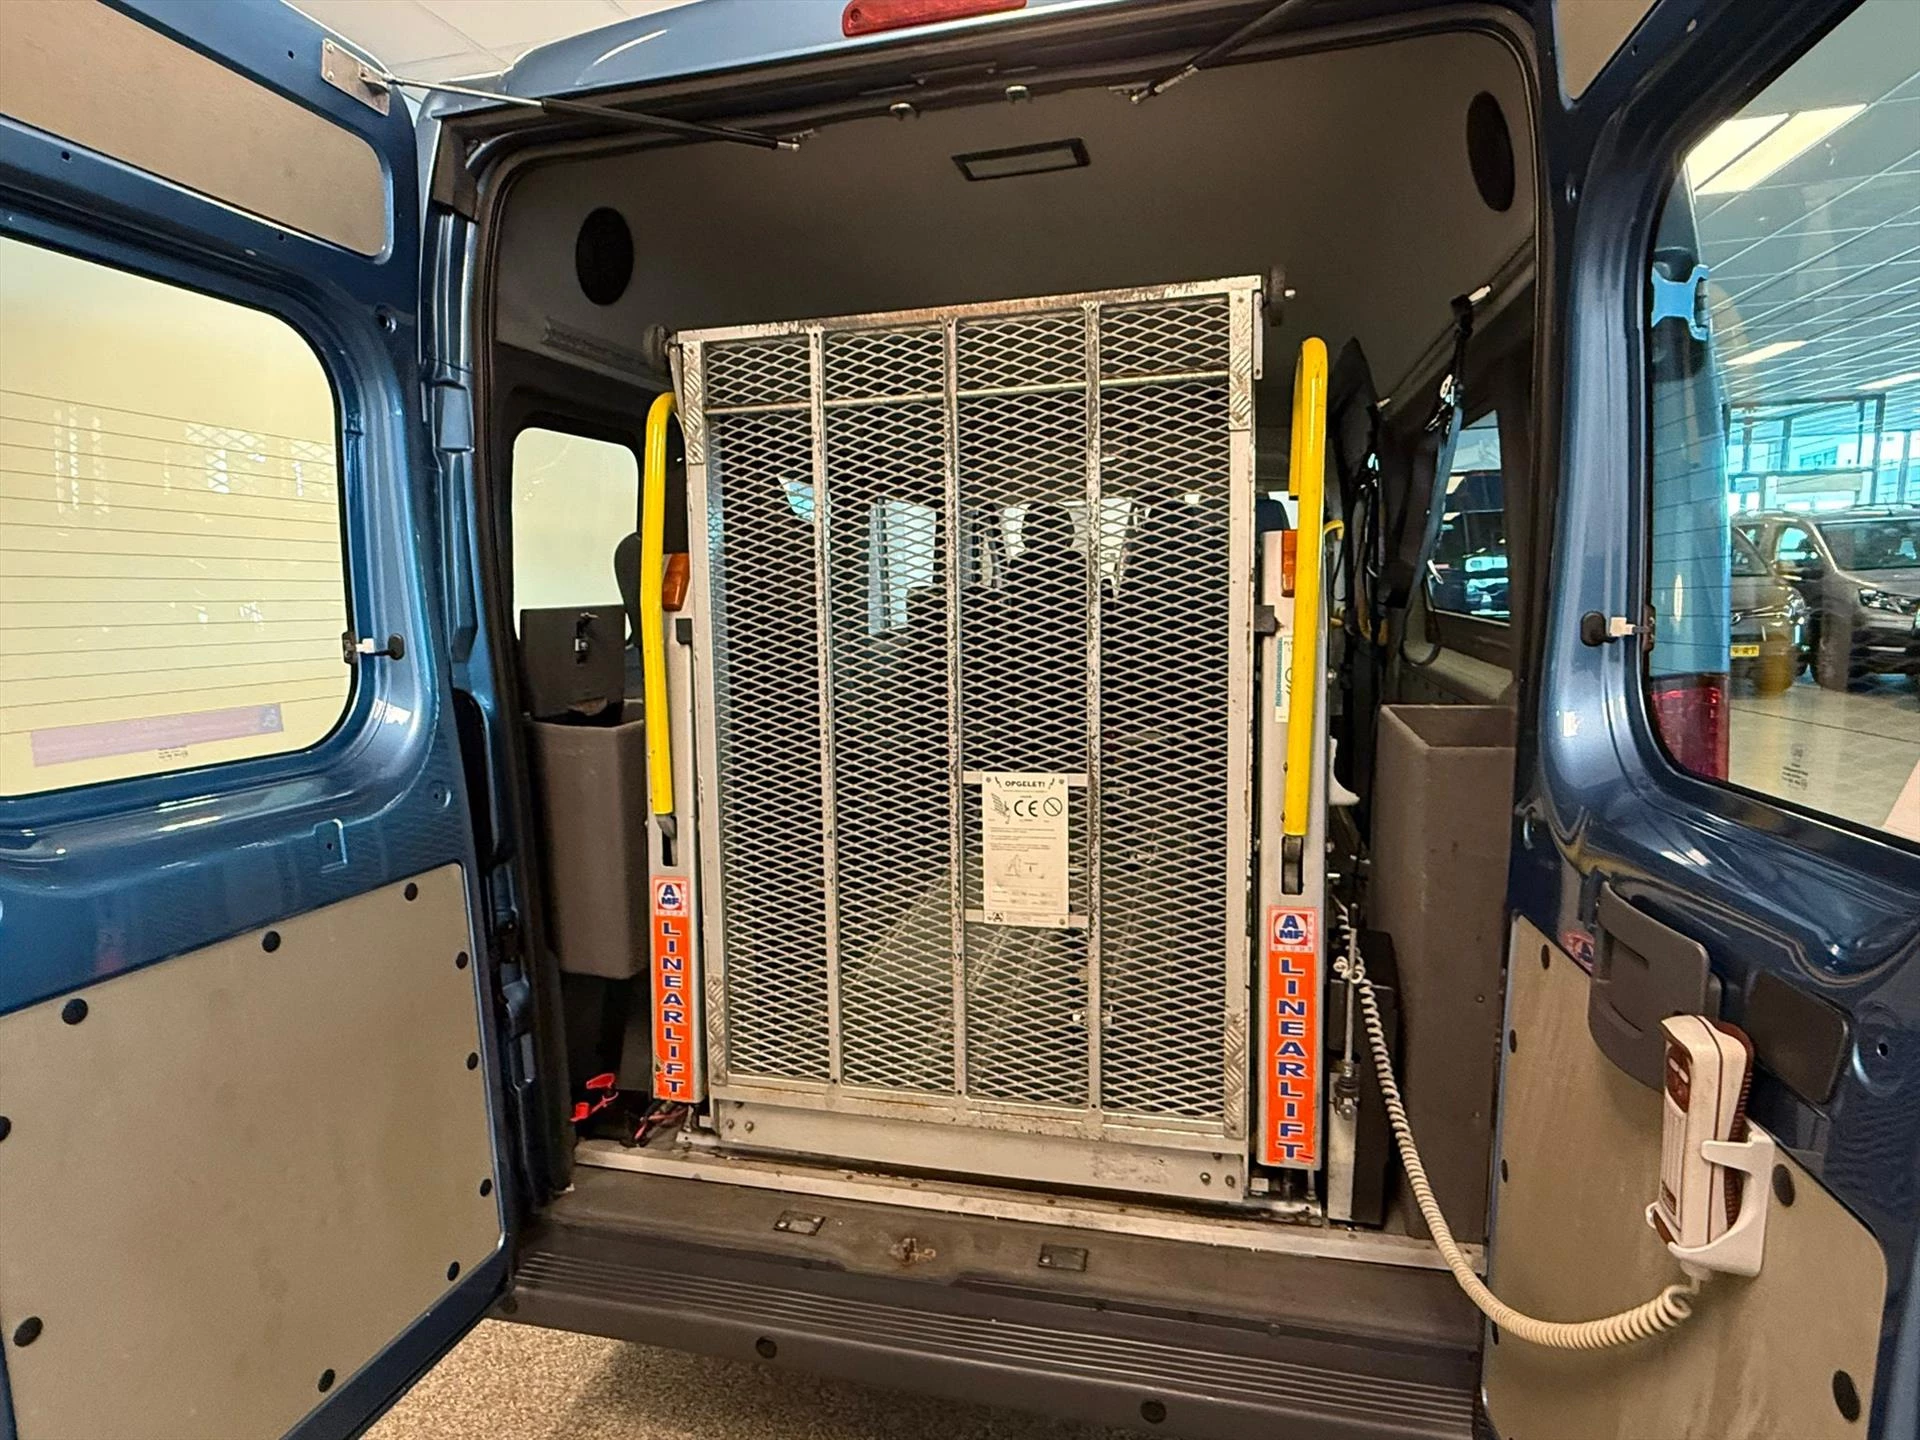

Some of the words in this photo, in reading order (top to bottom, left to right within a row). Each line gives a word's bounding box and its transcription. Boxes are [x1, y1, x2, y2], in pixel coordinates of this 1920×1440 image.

[1014, 800, 1038, 817] CE
[662, 922, 684, 1093] LINEARLIFT
[1278, 958, 1306, 1160] LINEARLIFT
